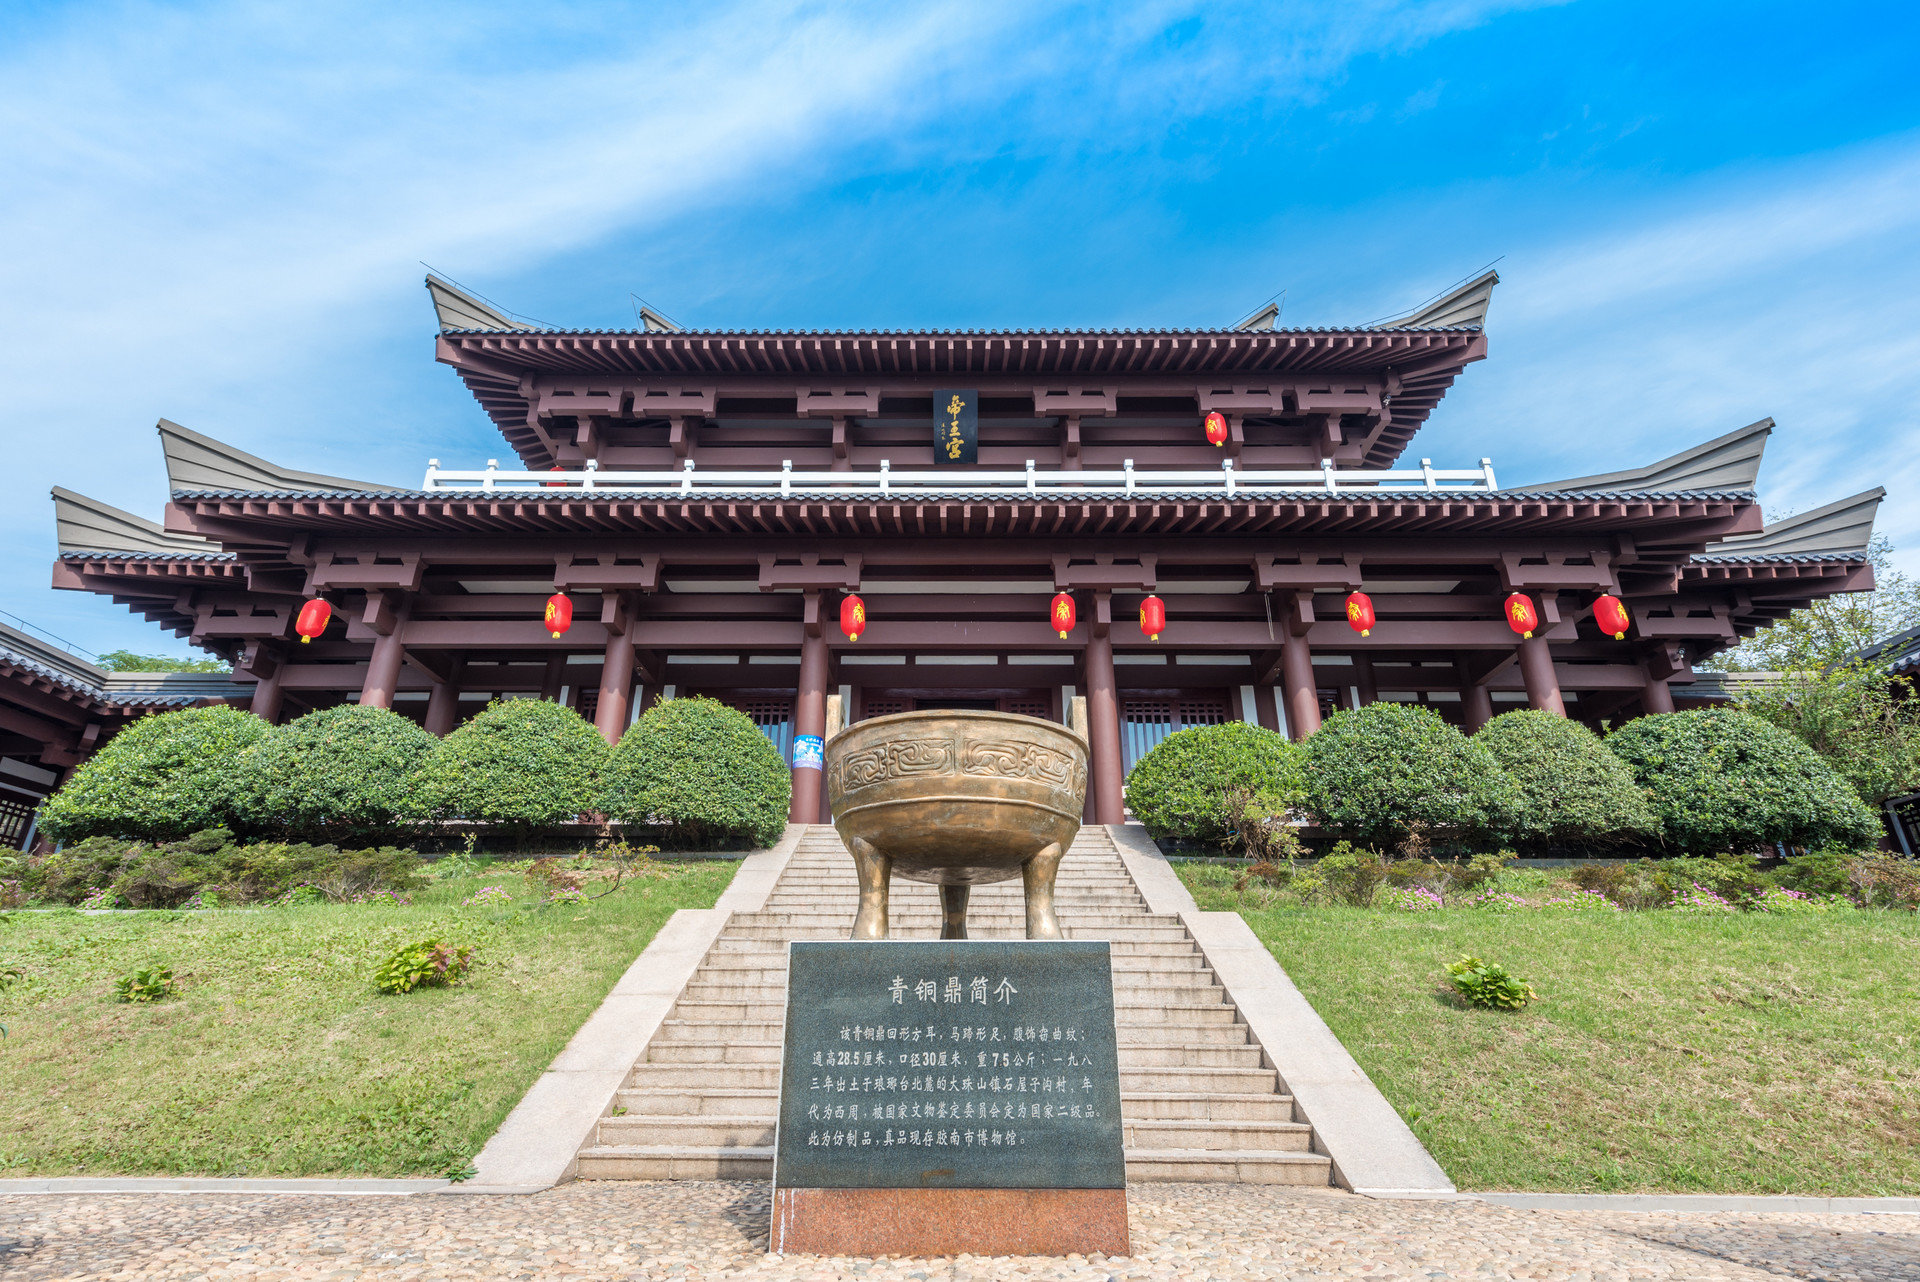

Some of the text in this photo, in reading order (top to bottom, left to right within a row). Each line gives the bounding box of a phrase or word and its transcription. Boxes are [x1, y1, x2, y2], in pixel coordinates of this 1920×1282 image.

[945, 395, 966, 459] 帝王宫
[887, 974, 1018, 1005] 青铜鼎简介
